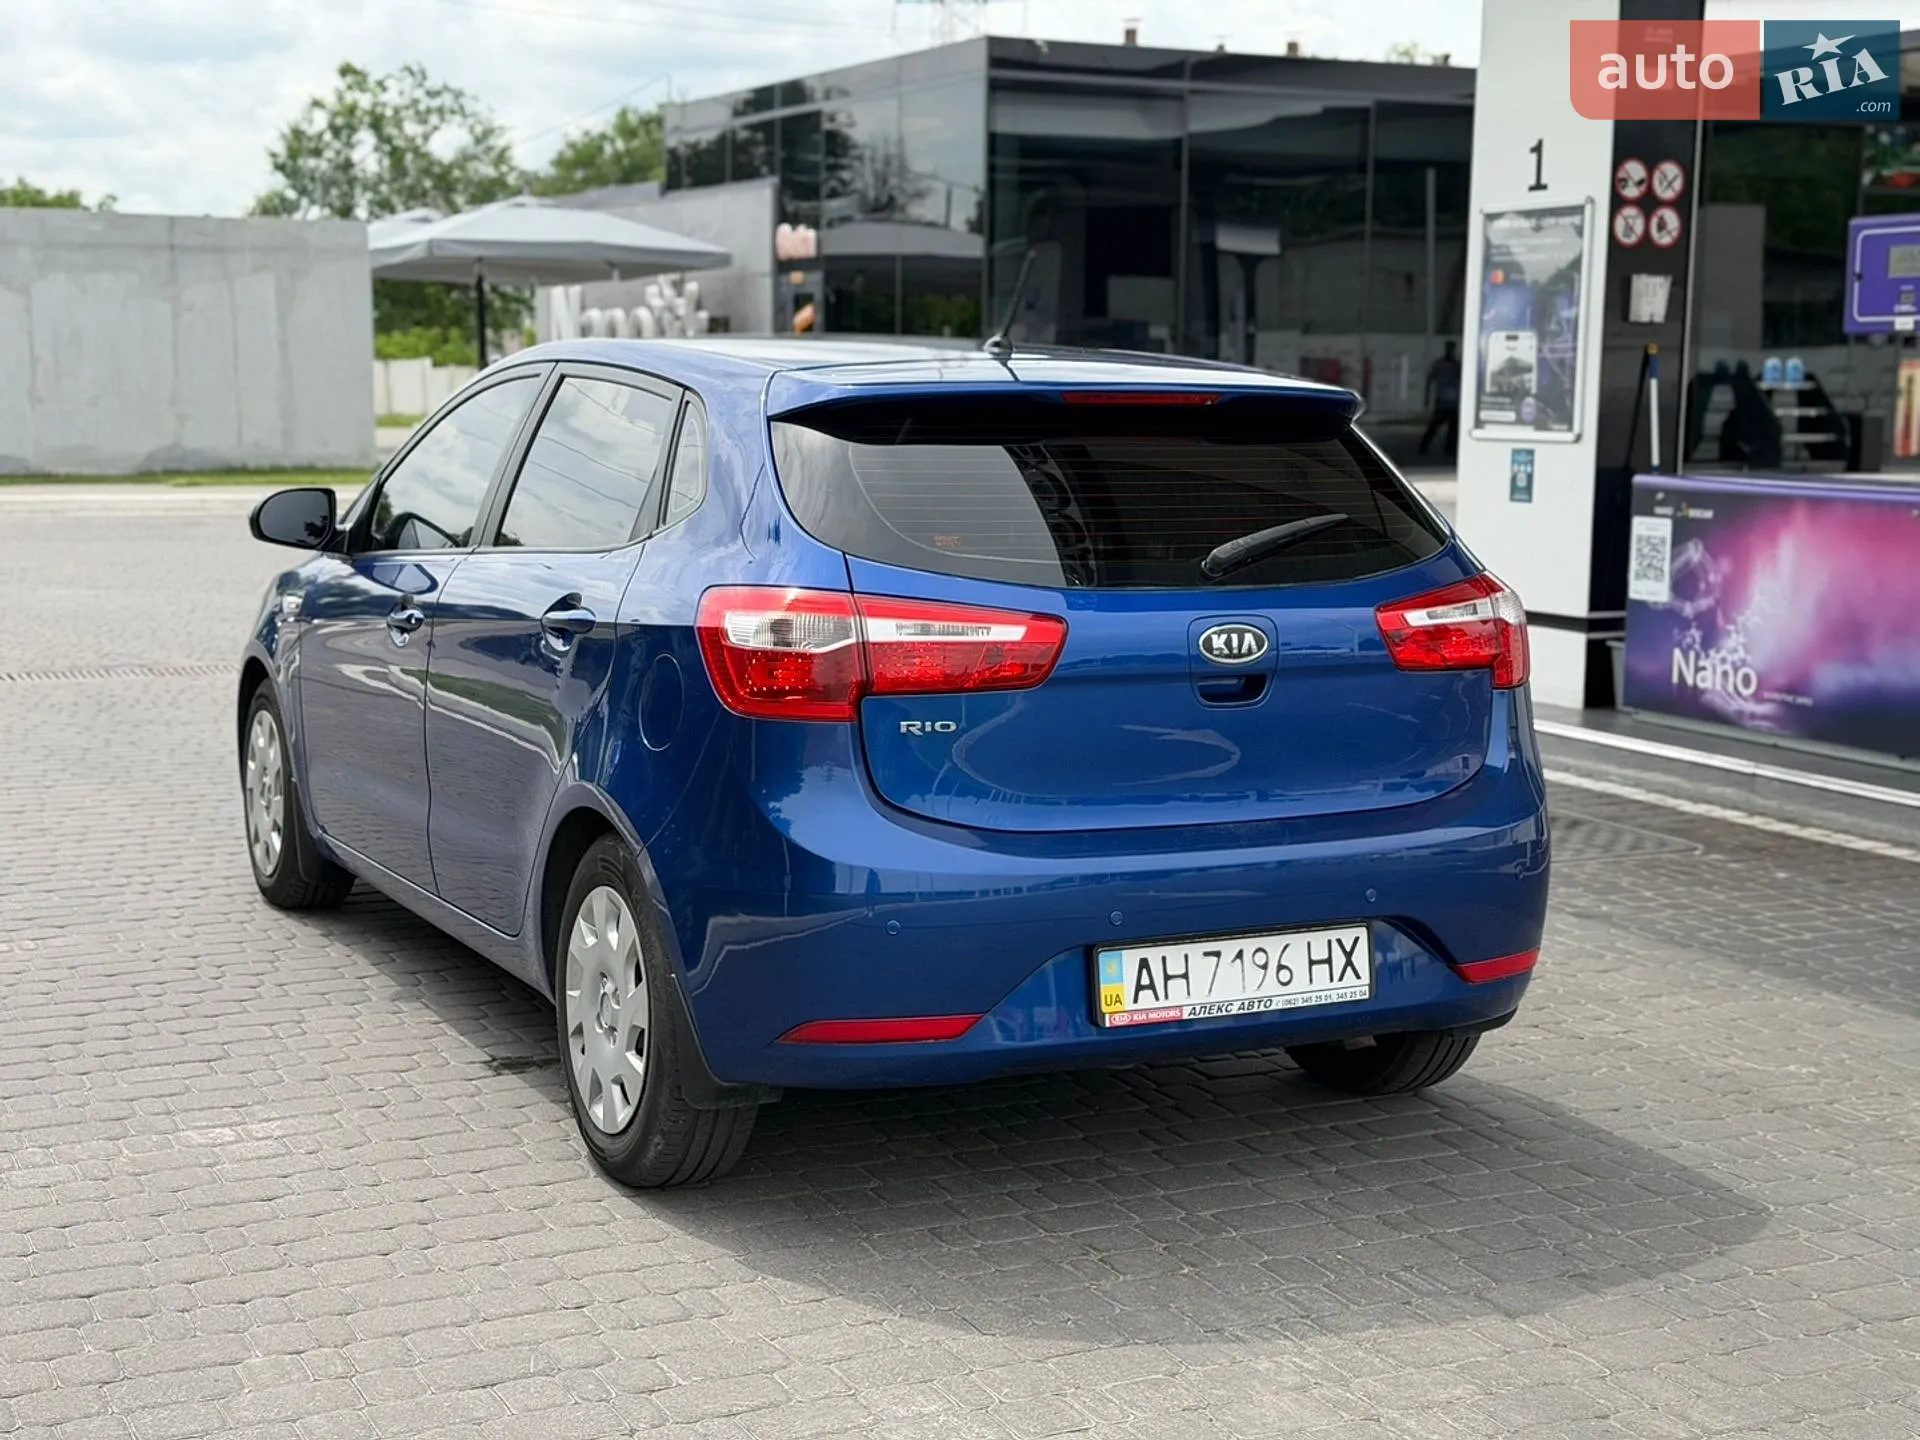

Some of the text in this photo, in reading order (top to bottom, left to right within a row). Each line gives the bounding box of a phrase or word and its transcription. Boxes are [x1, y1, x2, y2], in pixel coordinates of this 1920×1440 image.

[1528, 137, 1549, 192] 1
[1211, 632, 1259, 655] KIA
[1671, 647, 1757, 696] Nano
[900, 721, 957, 736] RIO
[1132, 936, 1362, 1004] AH 7196 HX
[1104, 994, 1123, 1007] UA
[1187, 998, 1274, 1018] АЛЕКС АВТО
[1133, 1010, 1181, 1021] KIA MOTORS
